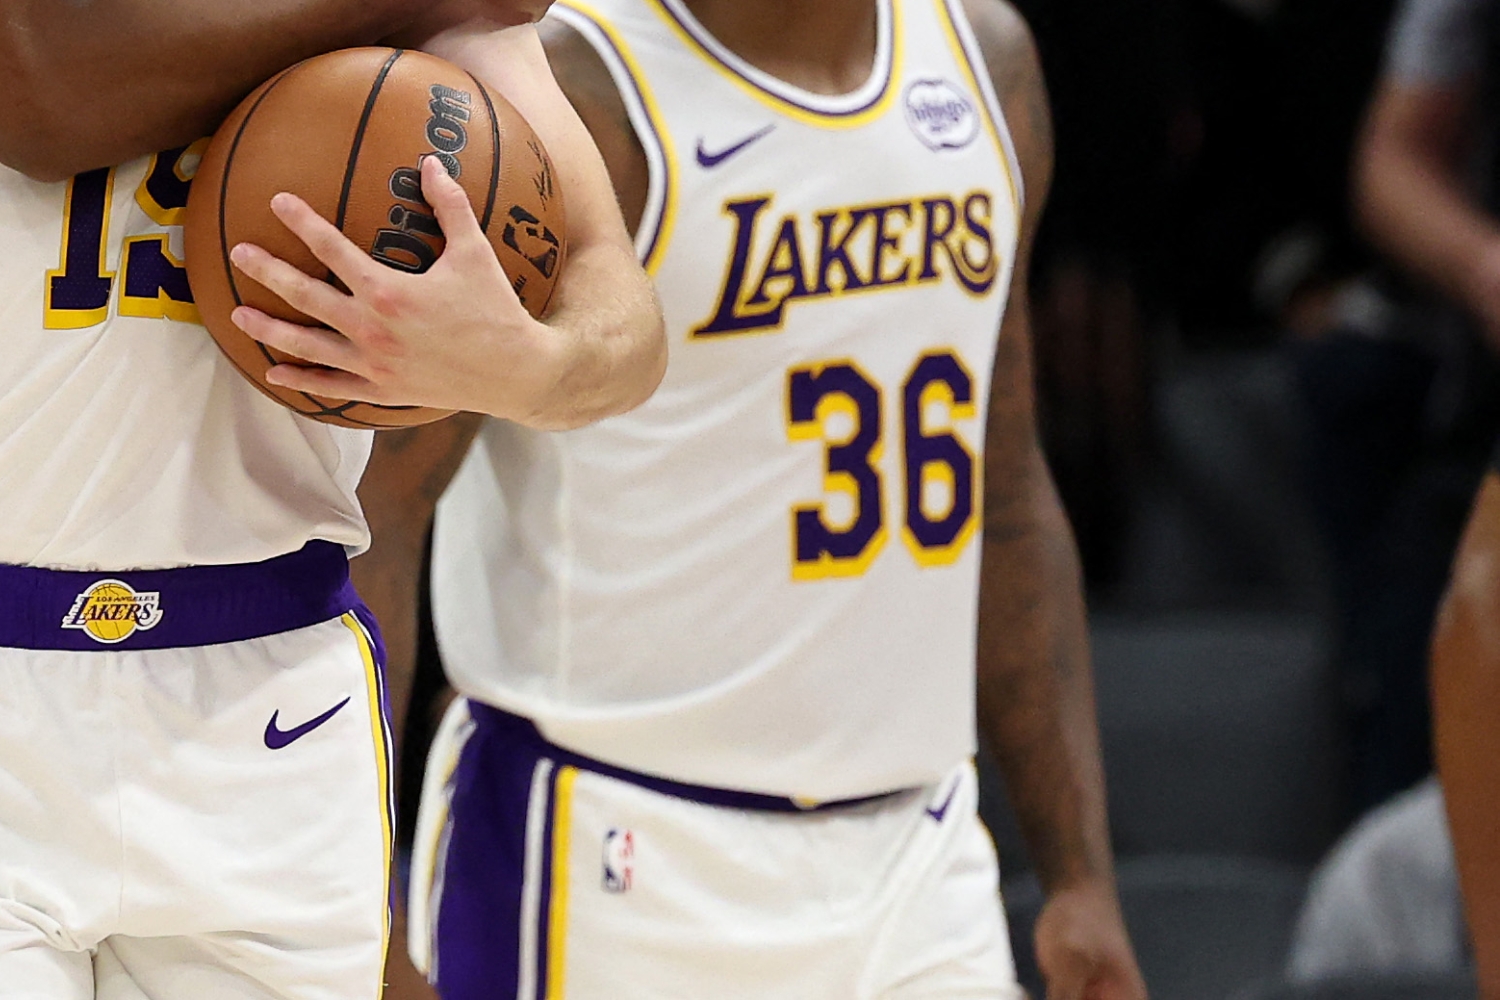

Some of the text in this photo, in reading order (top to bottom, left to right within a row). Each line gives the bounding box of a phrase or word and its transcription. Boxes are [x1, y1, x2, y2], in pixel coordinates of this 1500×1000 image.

[687, 190, 999, 341] LAKERS
[785, 346, 980, 581] 36
[66, 596, 158, 627] LAKERS
